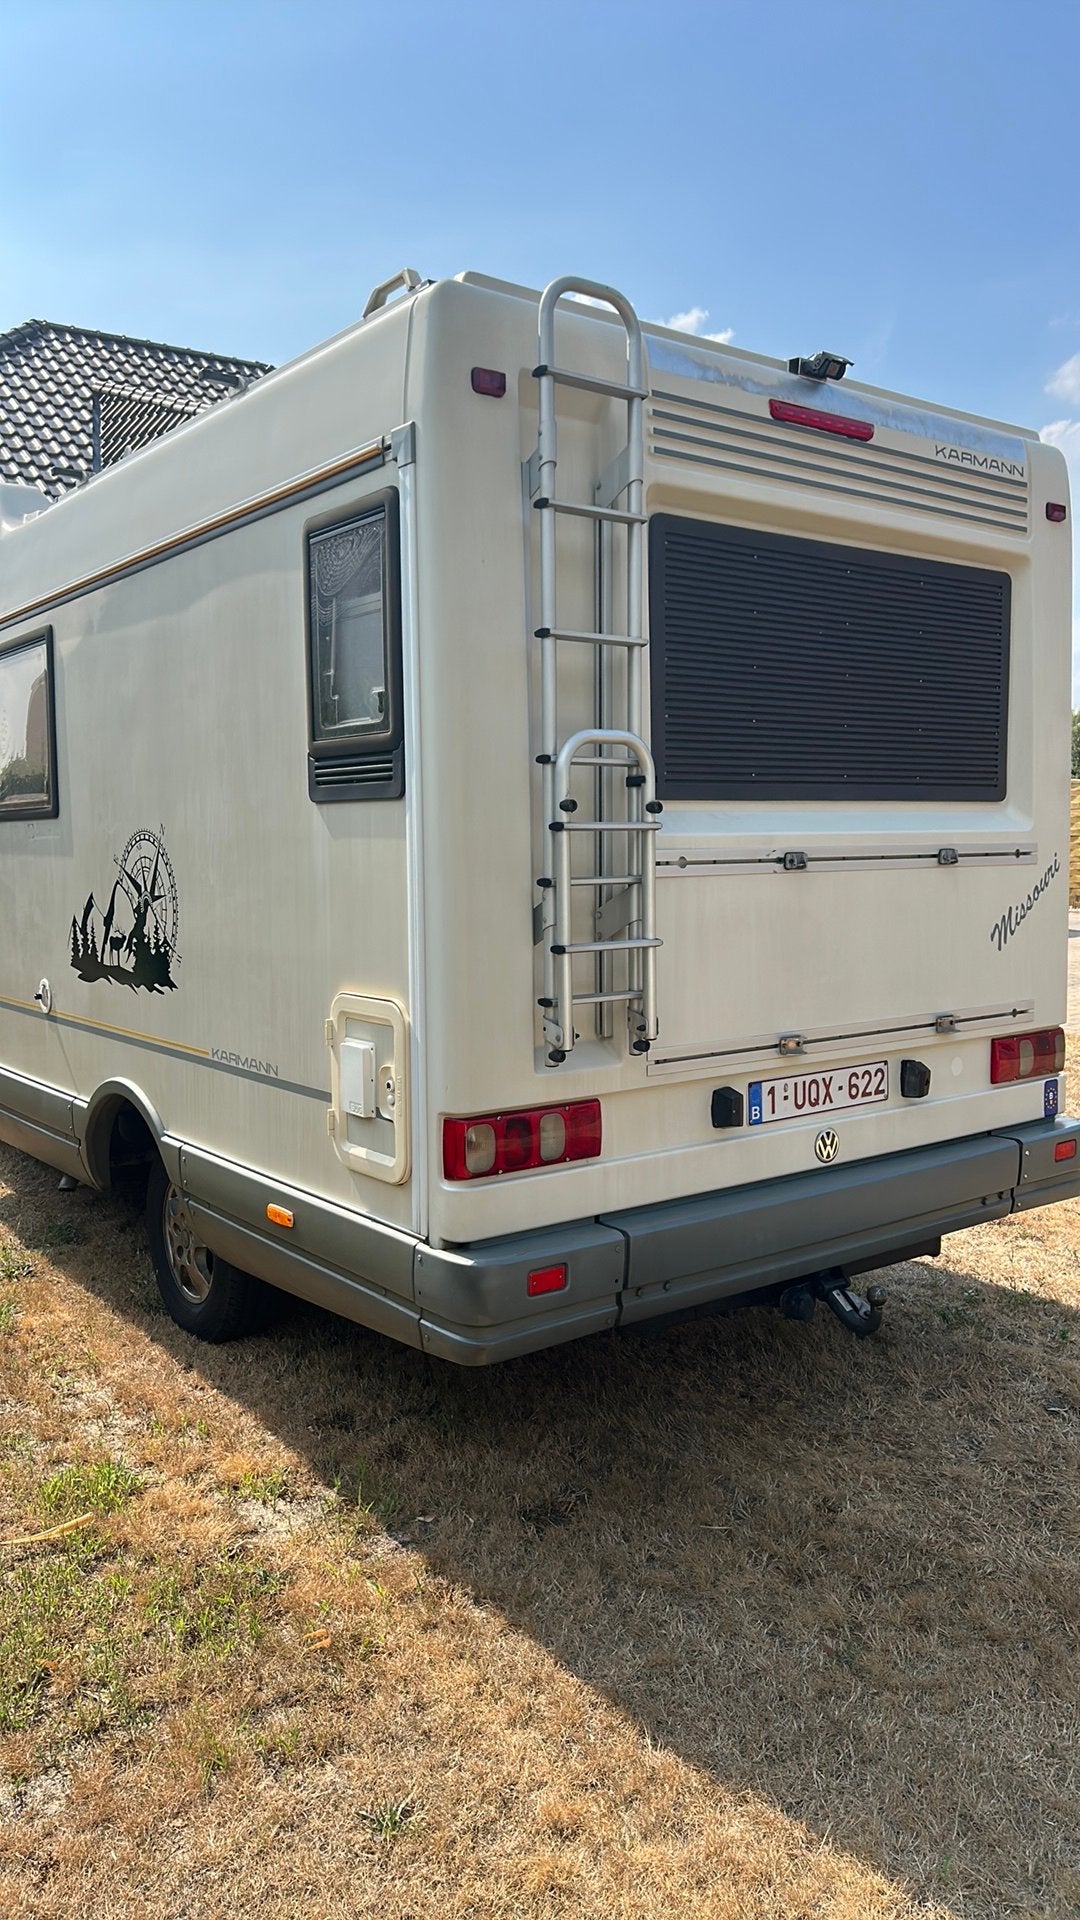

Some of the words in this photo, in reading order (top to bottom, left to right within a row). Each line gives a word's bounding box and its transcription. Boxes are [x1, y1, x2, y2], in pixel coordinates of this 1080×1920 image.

[935, 445, 1024, 478] KARMANN
[990, 852, 1060, 951] Missouri
[211, 1048, 279, 1077] KARMANN
[767, 1067, 886, 1115] 1-UQX-622
[751, 1106, 760, 1119] B
